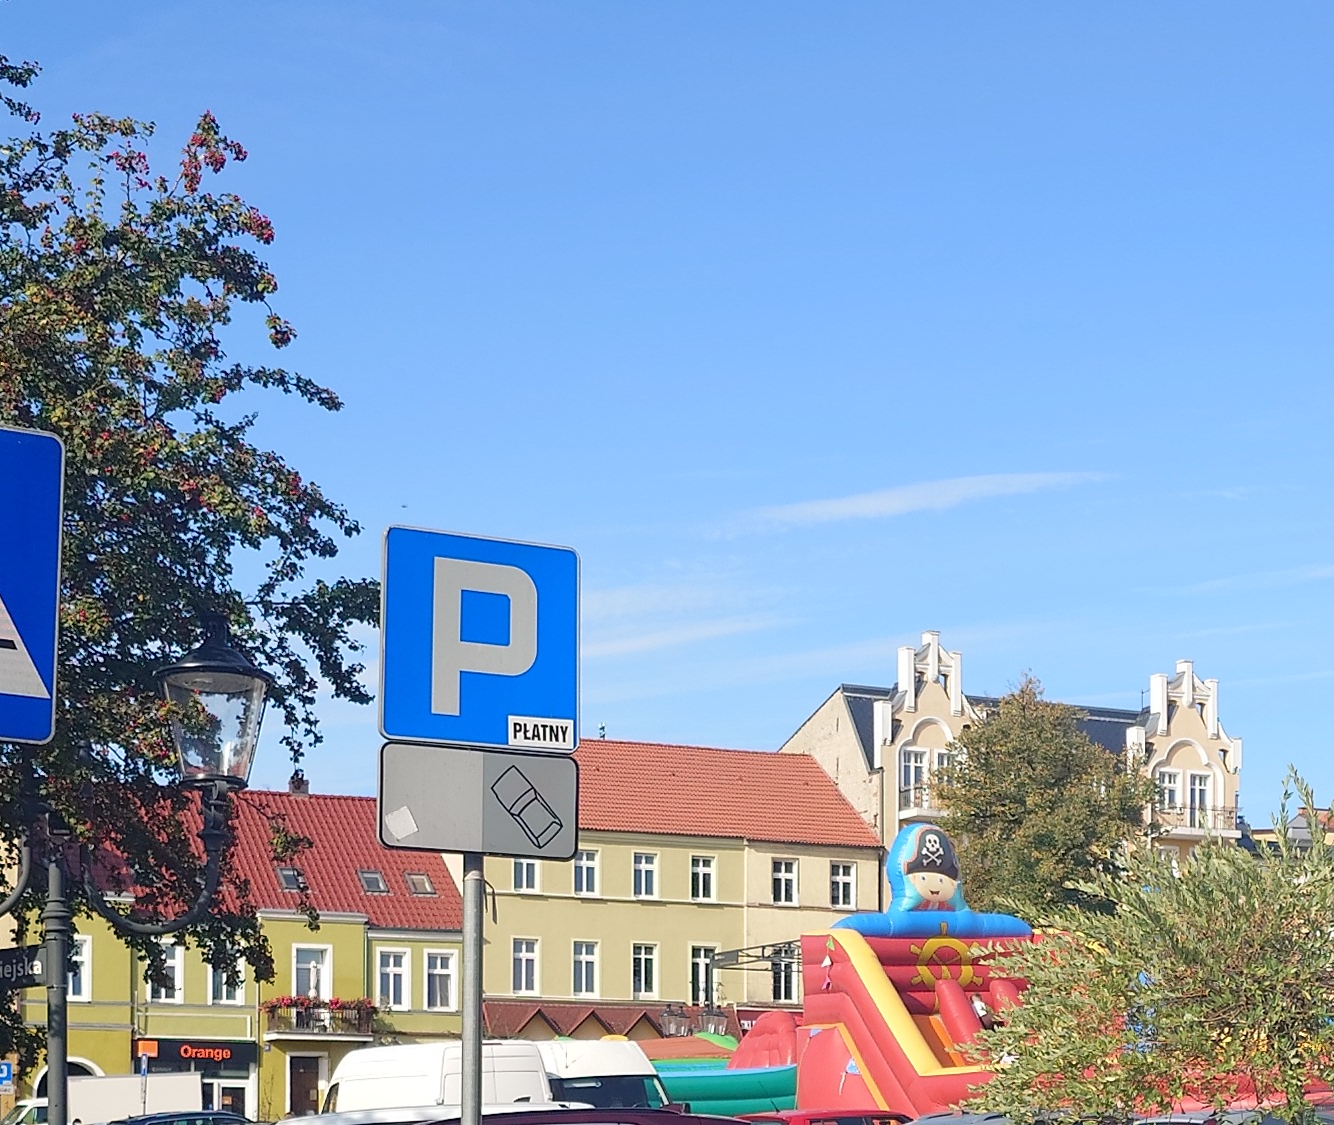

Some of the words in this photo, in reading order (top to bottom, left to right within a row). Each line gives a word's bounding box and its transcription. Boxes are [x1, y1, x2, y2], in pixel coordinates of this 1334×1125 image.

[431, 556, 538, 716] P
[513, 722, 569, 743] PŁATNY
[180, 1045, 231, 1061] Orange
